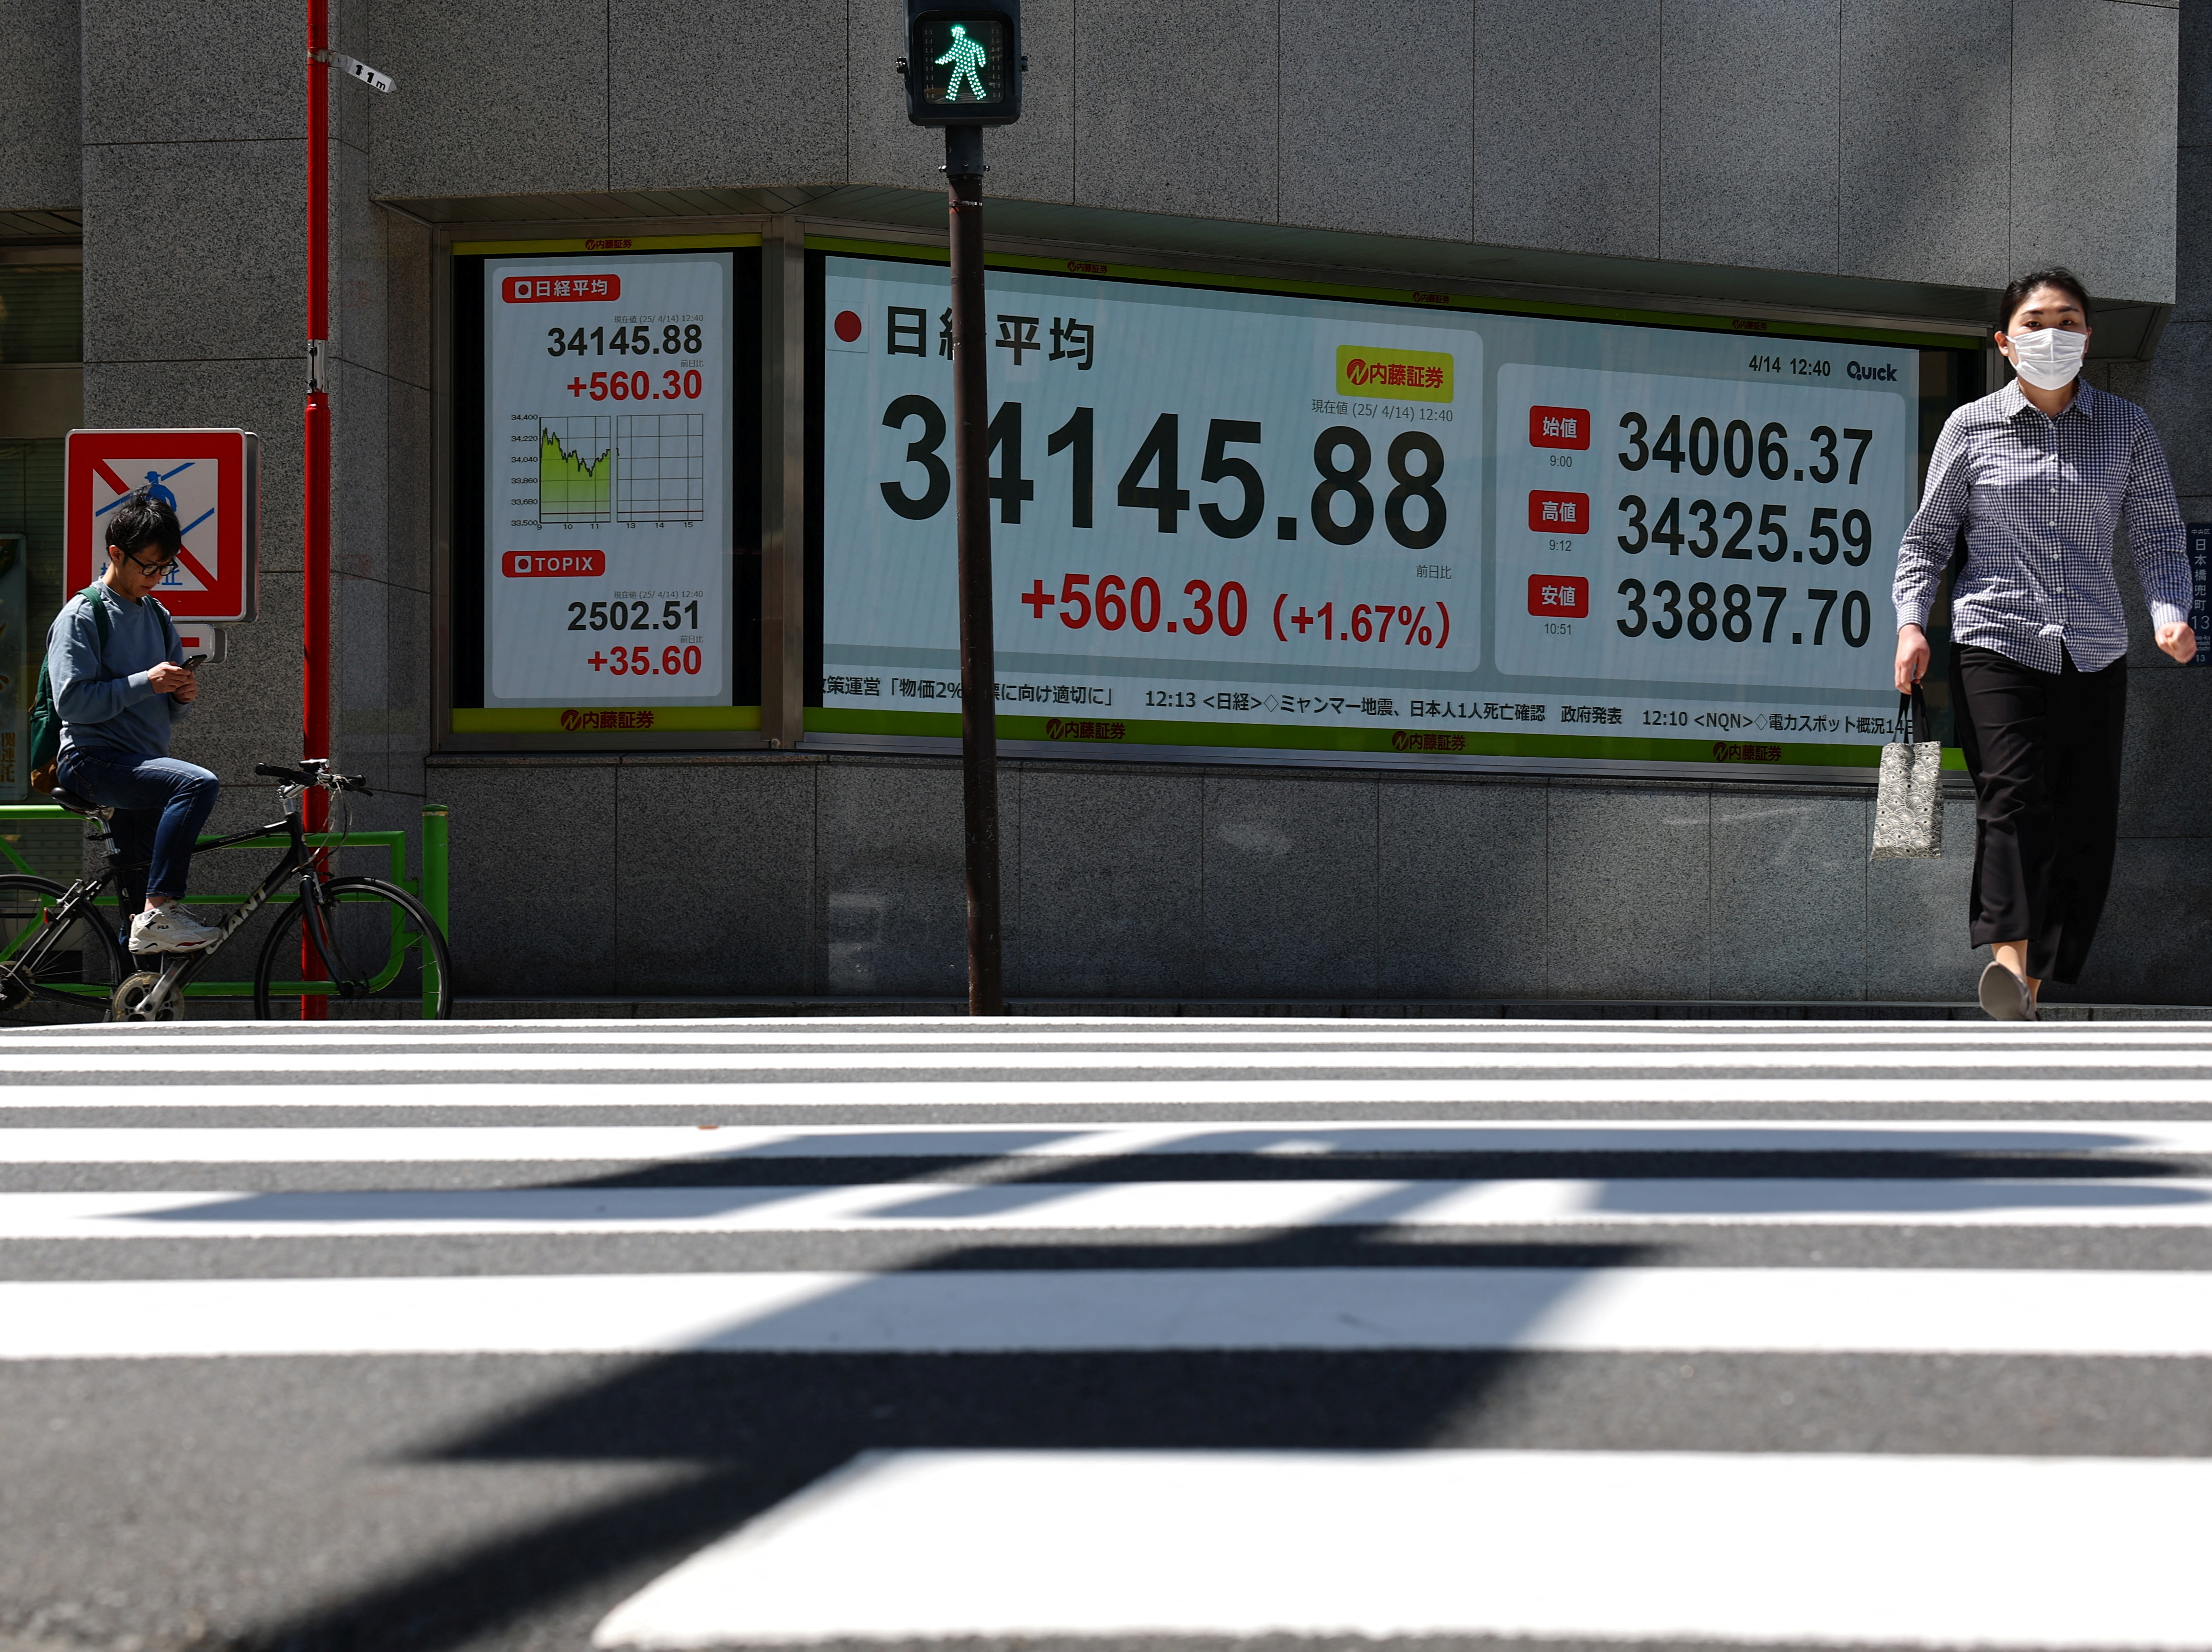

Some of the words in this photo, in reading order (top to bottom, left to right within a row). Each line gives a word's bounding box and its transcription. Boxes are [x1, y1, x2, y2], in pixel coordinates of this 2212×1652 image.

[596, 239, 632, 249] 内藤証券
[1076, 262, 1107, 274] 内藤証券
[537, 280, 607, 296] 日経平均
[1421, 294, 1450, 304] 内藤証券
[1741, 321, 1767, 330] 内藤証券
[547, 324, 702, 356] 34145.88
[1370, 363, 1443, 388] 内藤証券
[1749, 355, 1780, 373] 4/14
[1790, 358, 1830, 376] 12:40
[568, 370, 701, 400] +560.30
[1312, 399, 1348, 414] 現在値
[1420, 409, 1452, 422] 12:40
[1543, 417, 1576, 438] 始値
[1619, 412, 1872, 484] 34006.37
[880, 394, 1447, 549] 34145.88
[1550, 456, 1572, 467] 9:00
[1542, 501, 1575, 522] 高値
[1618, 495, 1871, 566] 34325.59
[1550, 540, 1571, 551] 9:12
[536, 558, 593, 571] TOPIX
[1416, 565, 1451, 579] 前日比
[2194, 539, 2207, 610] 日本橋兜町
[1542, 585, 1575, 605] 安値
[568, 601, 697, 630] 2502.51
[1022, 574, 1247, 636] +560.30
[1274, 594, 1449, 649] (+1.67%)
[1617, 579, 1870, 648] 33887.70
[1545, 623, 1571, 635] 10:51
[2191, 616, 2210, 629] 13
[588, 646, 701, 675] +35.60
[1146, 691, 1195, 707] 12:13
[1561, 706, 1622, 724] 政府発表
[1643, 710, 1688, 726] 12:10
[582, 711, 654, 729] 内藤証券
[1065, 722, 1125, 740] 内藤証券
[1410, 733, 1465, 751] 内藤証券
[1730, 743, 1781, 762] 内藤証券
